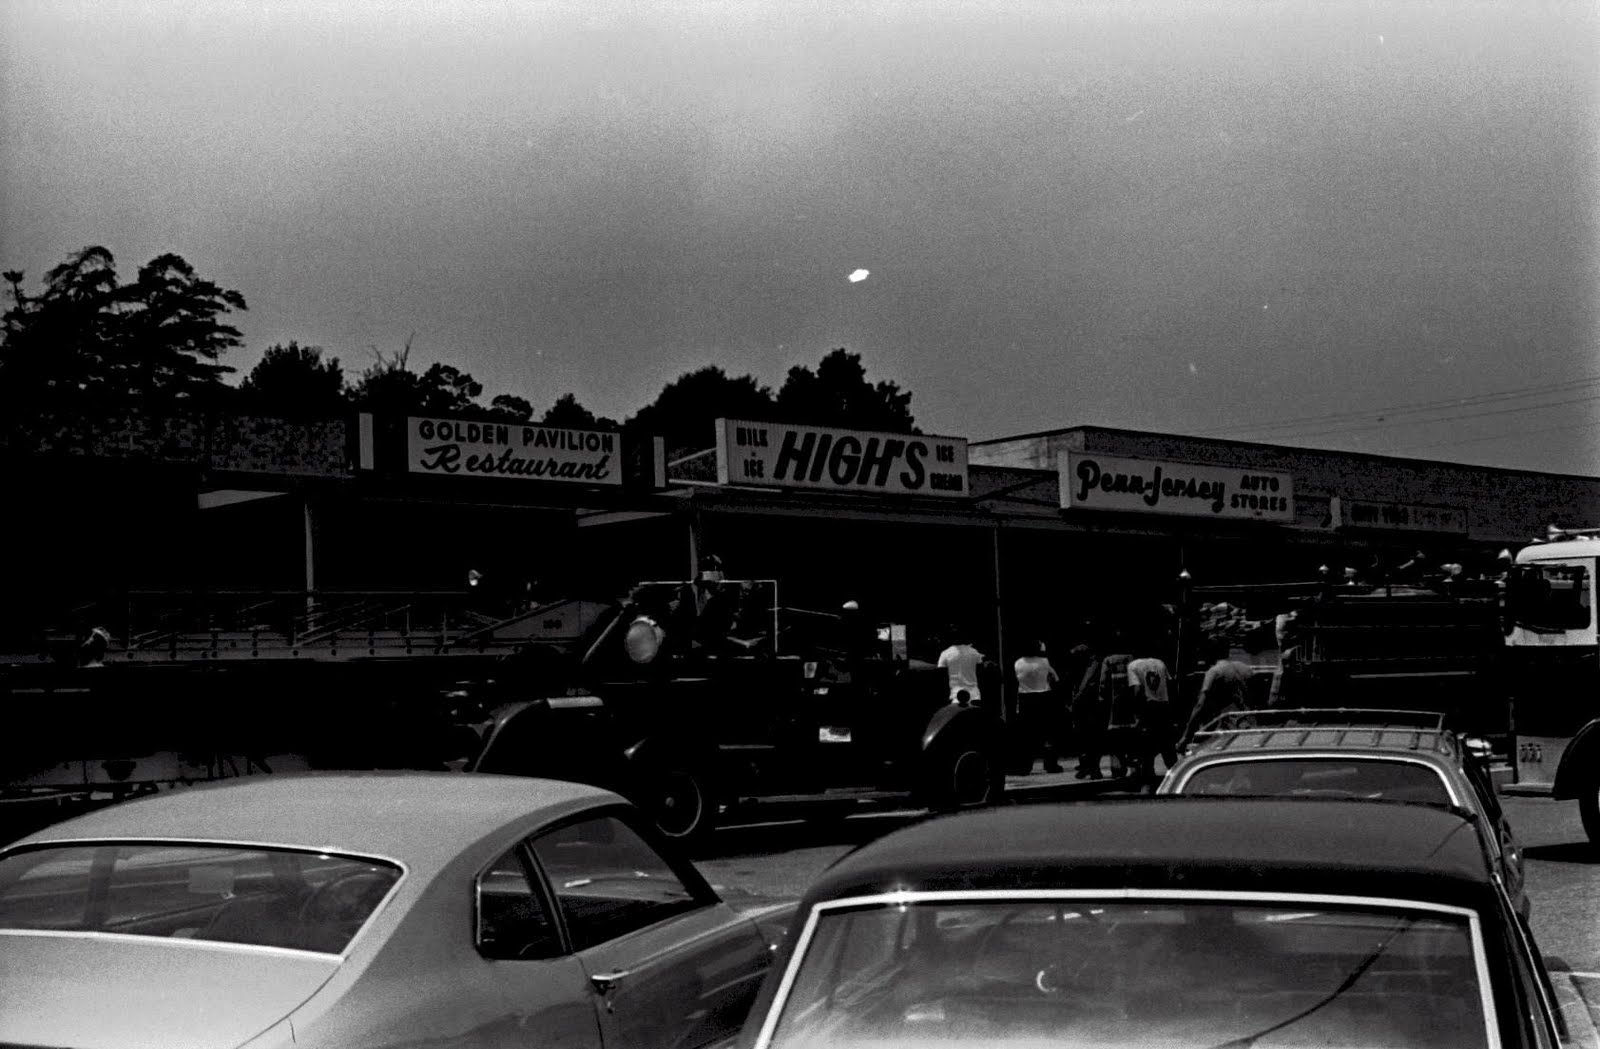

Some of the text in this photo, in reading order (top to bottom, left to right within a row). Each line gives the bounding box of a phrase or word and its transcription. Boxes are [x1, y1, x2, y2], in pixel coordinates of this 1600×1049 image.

[419, 420, 613, 452] GOLDEN PAVILION
[736, 427, 768, 447] MILK
[420, 444, 610, 479] Restaurant
[744, 459, 764, 478] ICE
[773, 431, 929, 489] HIGH'S
[1077, 460, 1225, 513] Penn-Jersey
[1240, 475, 1280, 492] AUTO
[1230, 494, 1287, 511] STORES
